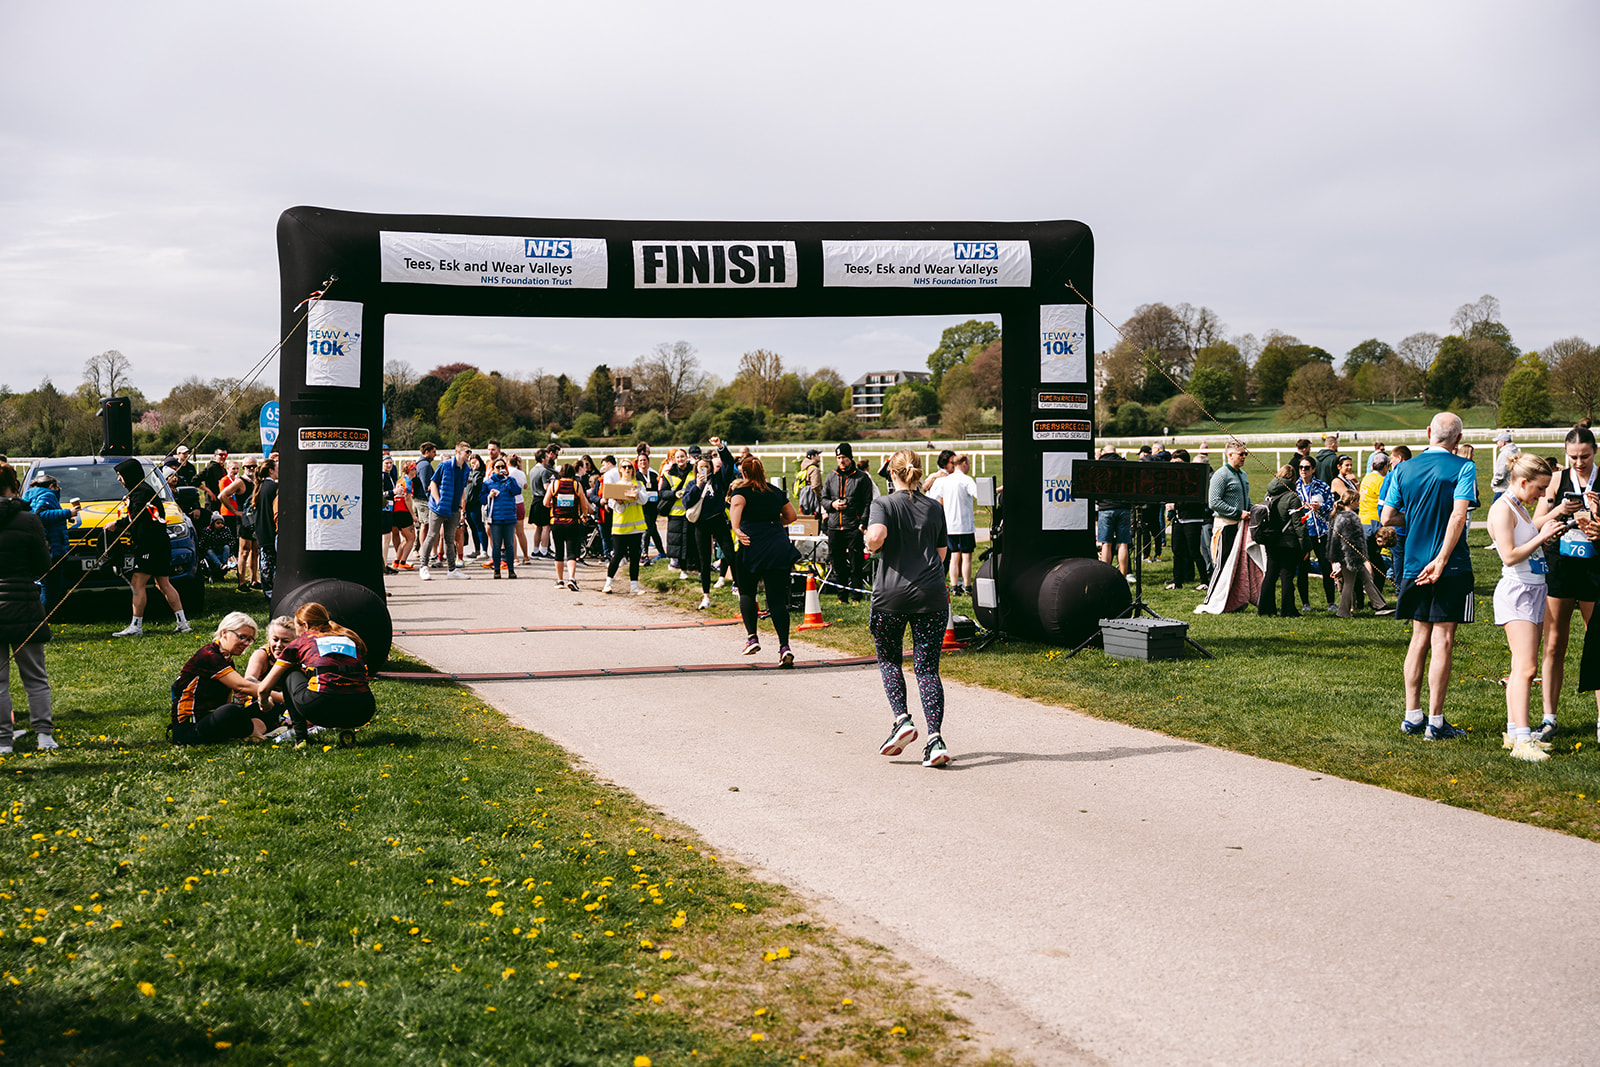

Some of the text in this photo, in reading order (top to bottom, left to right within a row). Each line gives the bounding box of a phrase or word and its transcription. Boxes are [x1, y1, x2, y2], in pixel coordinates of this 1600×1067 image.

[525, 239, 571, 258] NHS
[955, 243, 997, 259] NHS
[404, 257, 573, 277] Tees, Esk and Wear Valleys
[642, 244, 786, 285] FINISH
[844, 263, 998, 277] Tees, Esk and Wear Valleys
[480, 275, 573, 286] NHS Foundation Trust
[913, 277, 998, 285] NHS Foundation Trust
[309, 330, 341, 340] TEWV
[1042, 332, 1071, 341] TEWV
[309, 340, 345, 356] 10k
[1042, 340, 1074, 355] 10k
[317, 441, 338, 449] TIMING
[340, 441, 368, 449] SERVICES
[309, 493, 341, 503] TEWV
[309, 504, 345, 520] 10k
[1570, 544, 1586, 557] 76
[330, 645, 345, 653] 57
